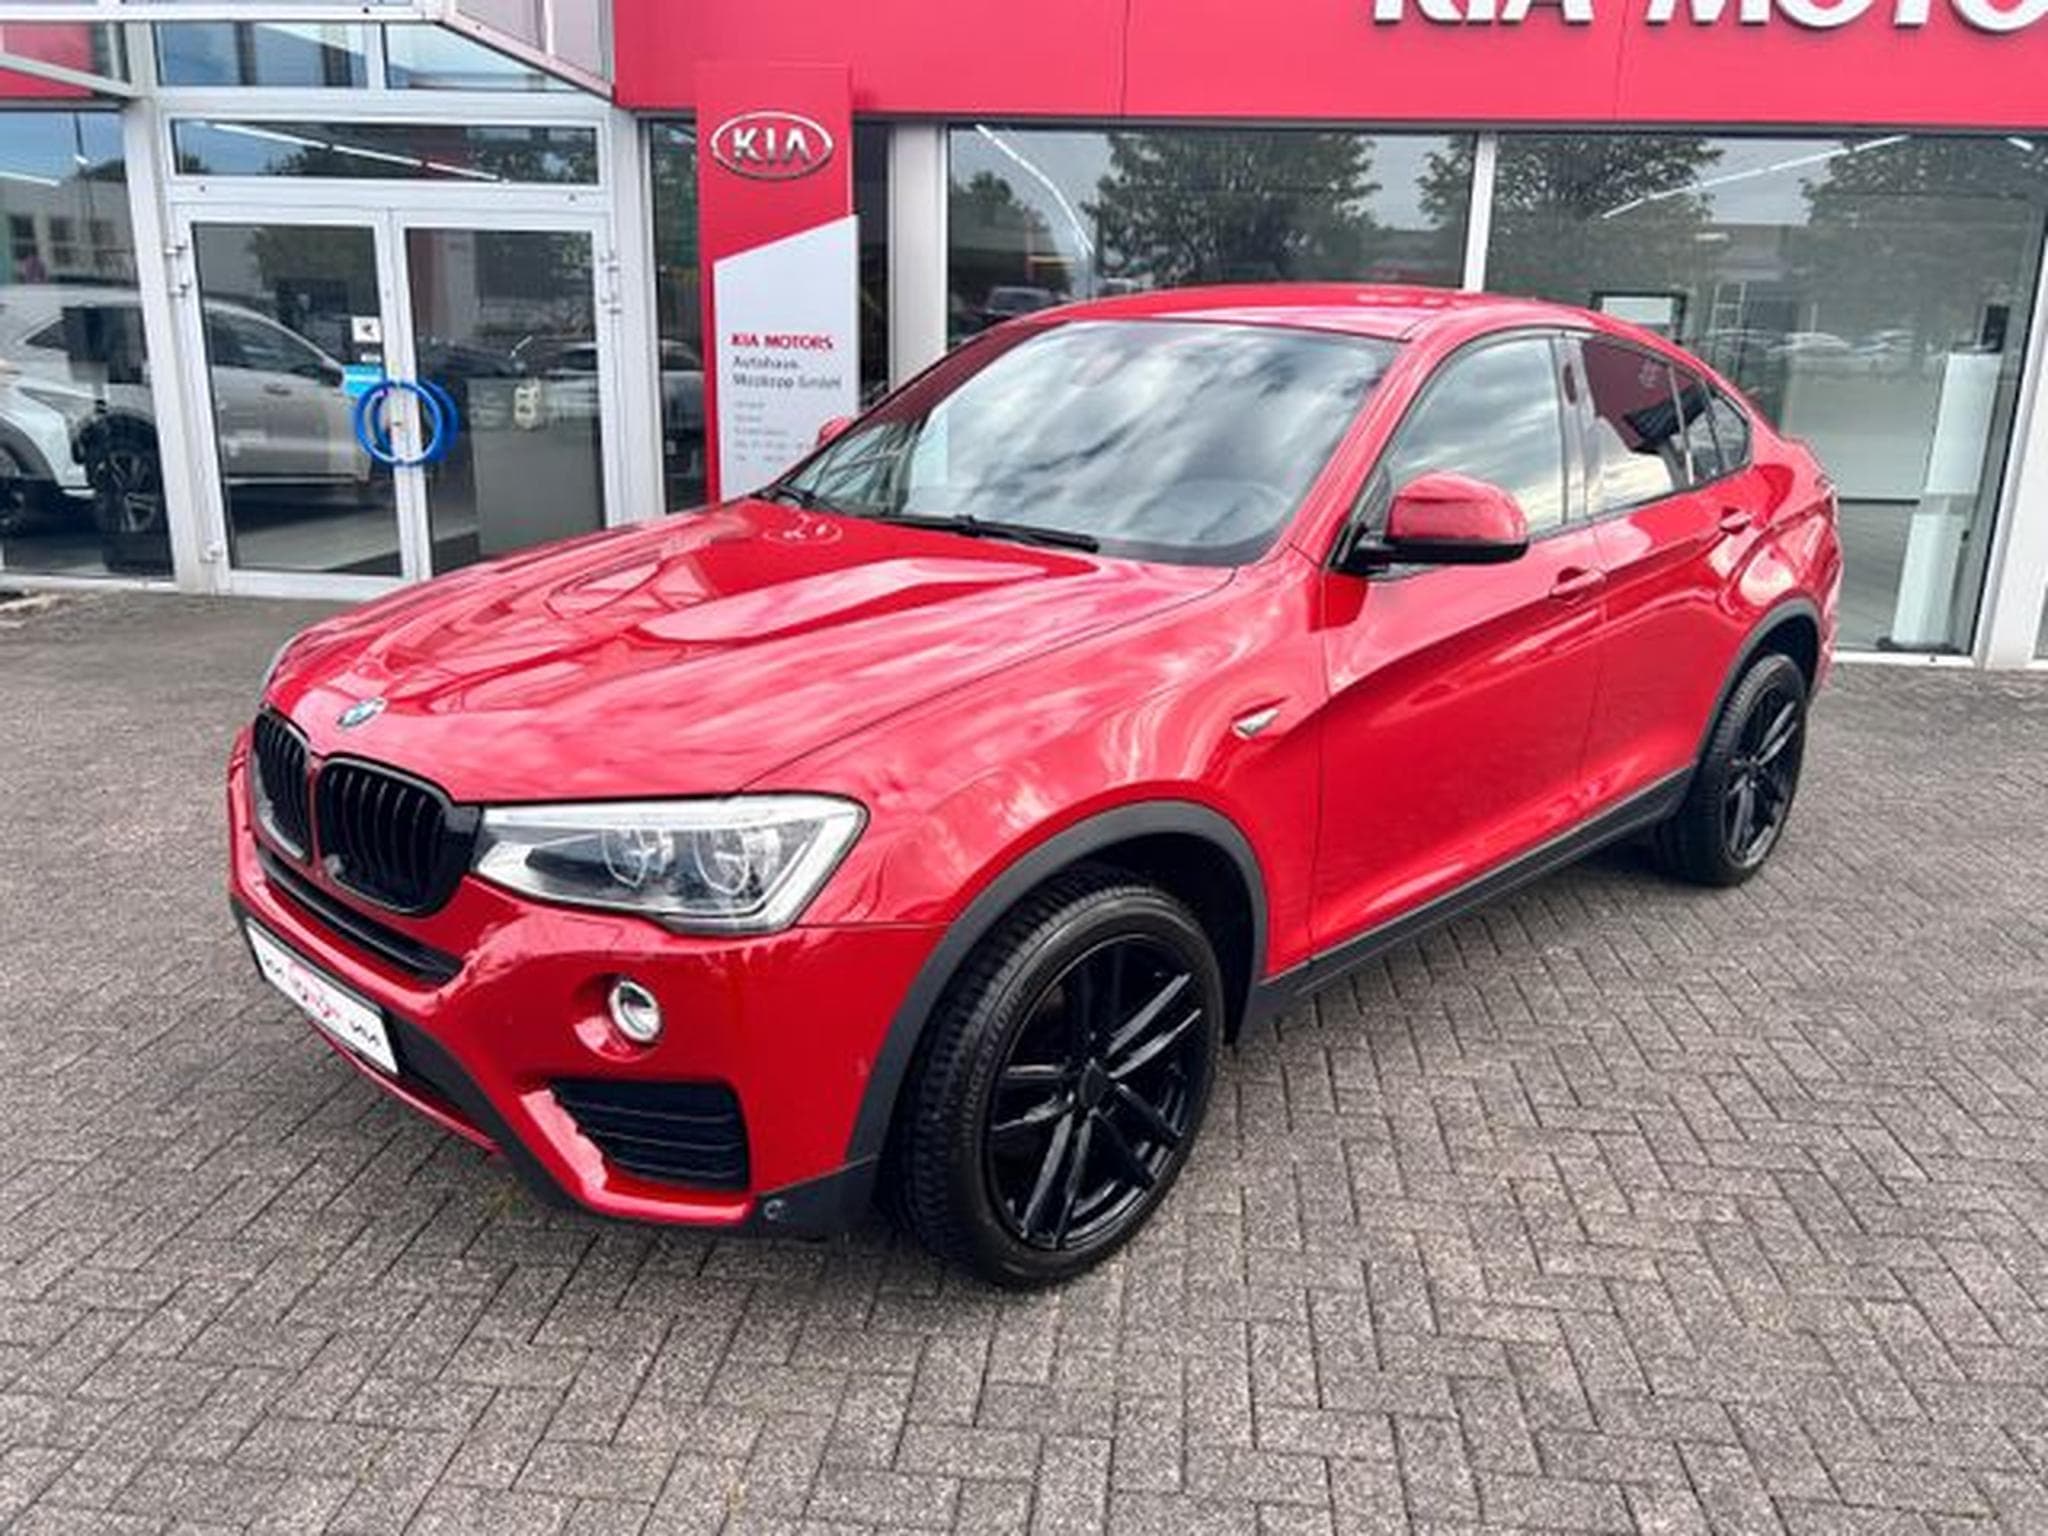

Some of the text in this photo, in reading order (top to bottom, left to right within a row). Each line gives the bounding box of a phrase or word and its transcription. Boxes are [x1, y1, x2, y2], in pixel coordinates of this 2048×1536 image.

[732, 126, 812, 165] KIA
[731, 333, 833, 350] KIA MOTORS
